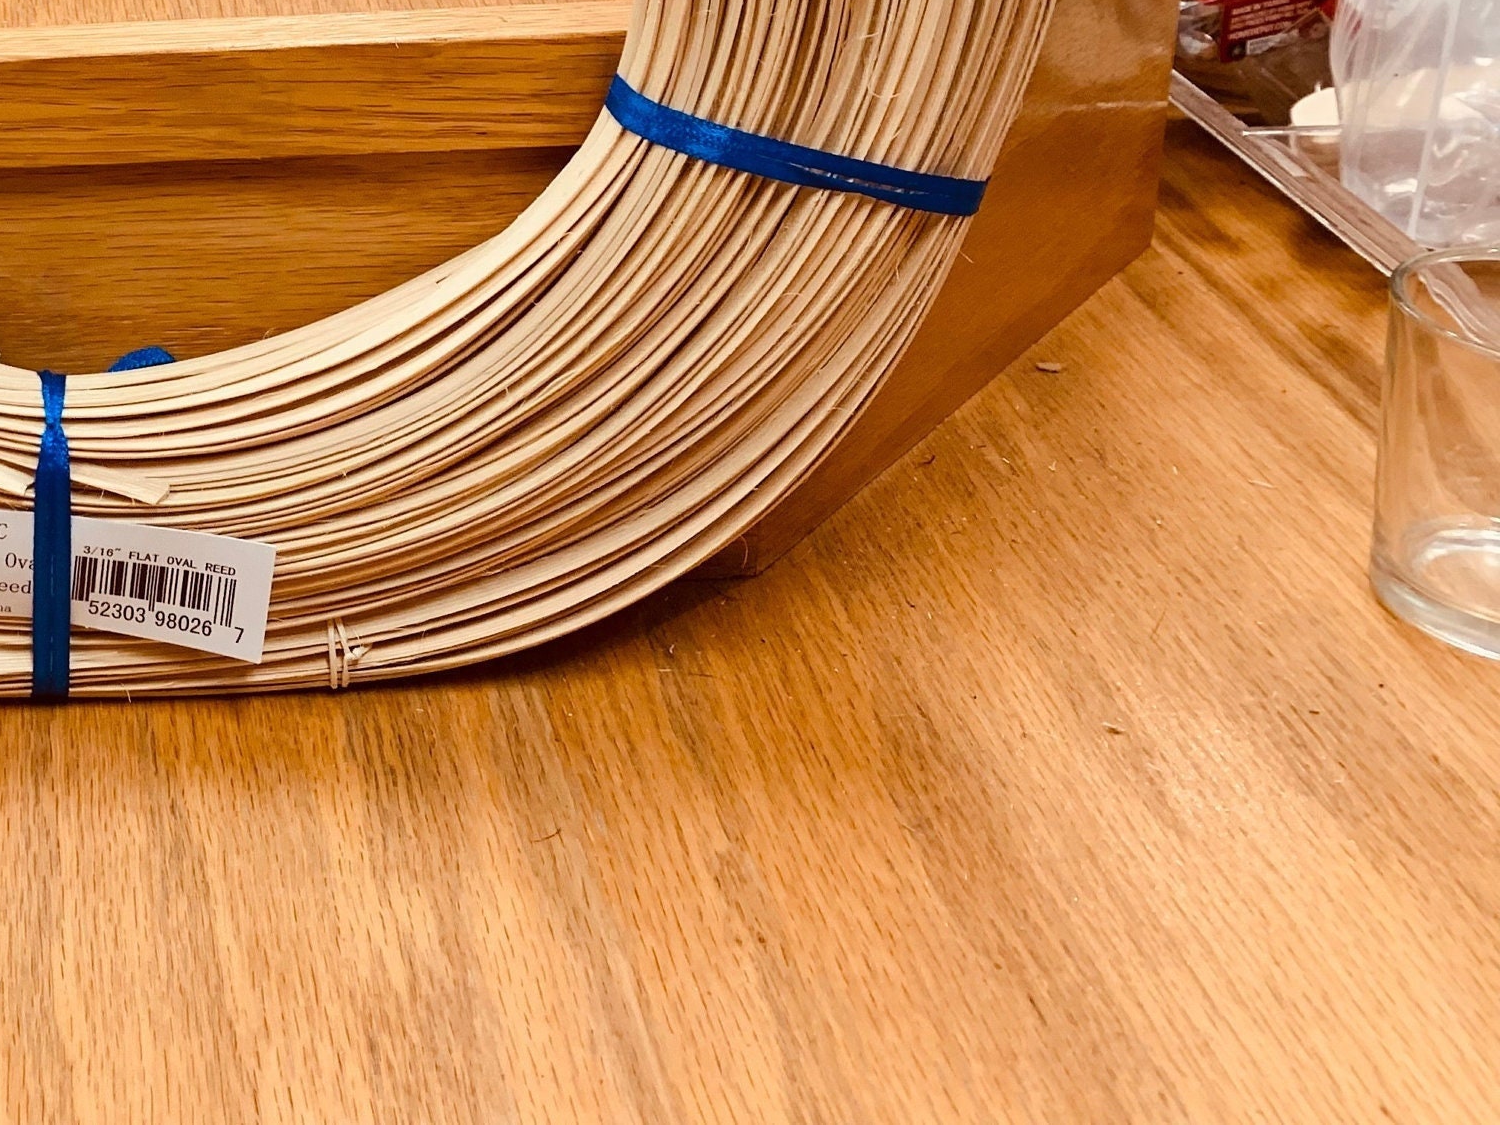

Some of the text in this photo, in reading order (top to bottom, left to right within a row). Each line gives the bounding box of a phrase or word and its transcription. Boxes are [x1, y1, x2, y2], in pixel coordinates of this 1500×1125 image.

[5, 552, 34, 570] Ova
[128, 551, 160, 563] FLAT
[167, 556, 197, 569] OVAL
[205, 563, 236, 575] REED
[88, 600, 244, 643] 52303 98026 7
